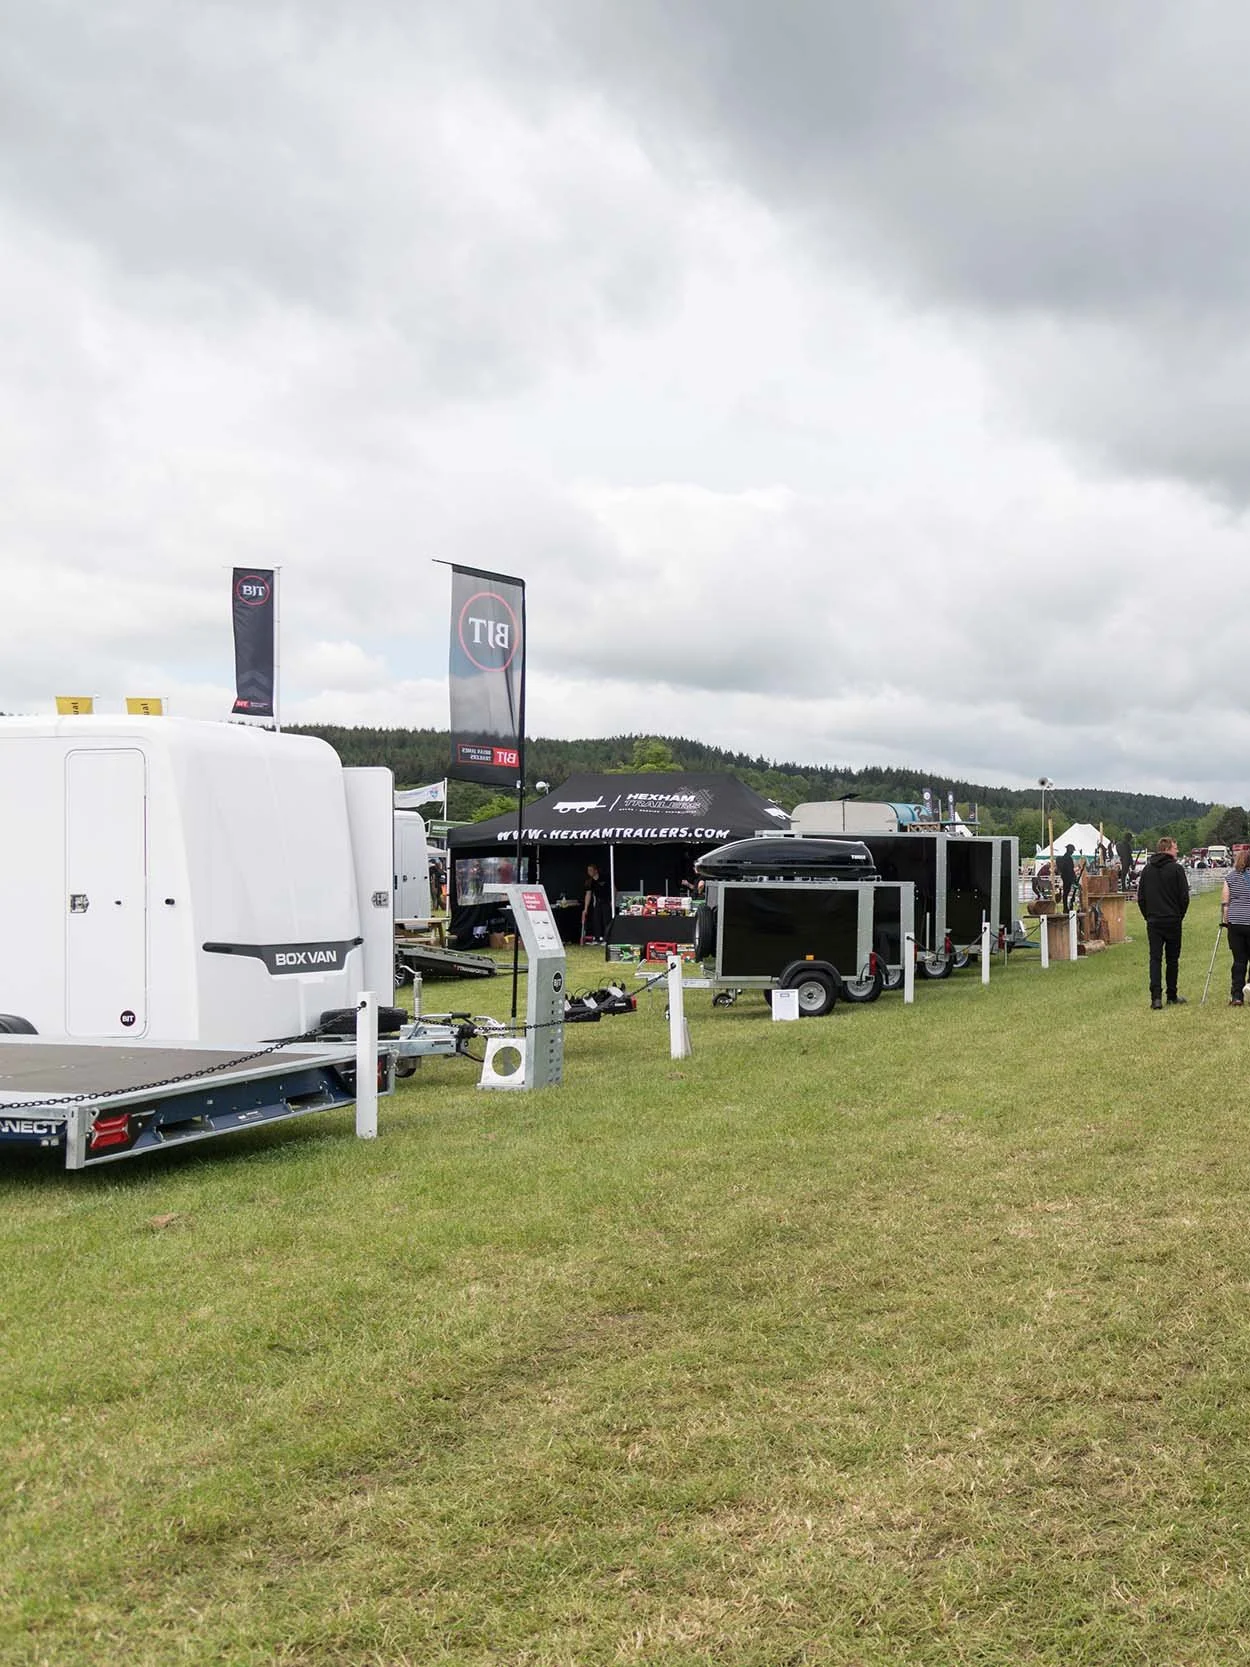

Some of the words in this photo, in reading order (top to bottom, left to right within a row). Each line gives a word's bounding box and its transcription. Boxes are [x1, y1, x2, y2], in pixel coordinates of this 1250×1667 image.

[242, 585, 265, 596] BJT
[626, 793, 696, 802] HEXHAM
[624, 800, 702, 809] TRAILERS
[275, 952, 307, 966] BOX
[307, 950, 337, 964] VAN
